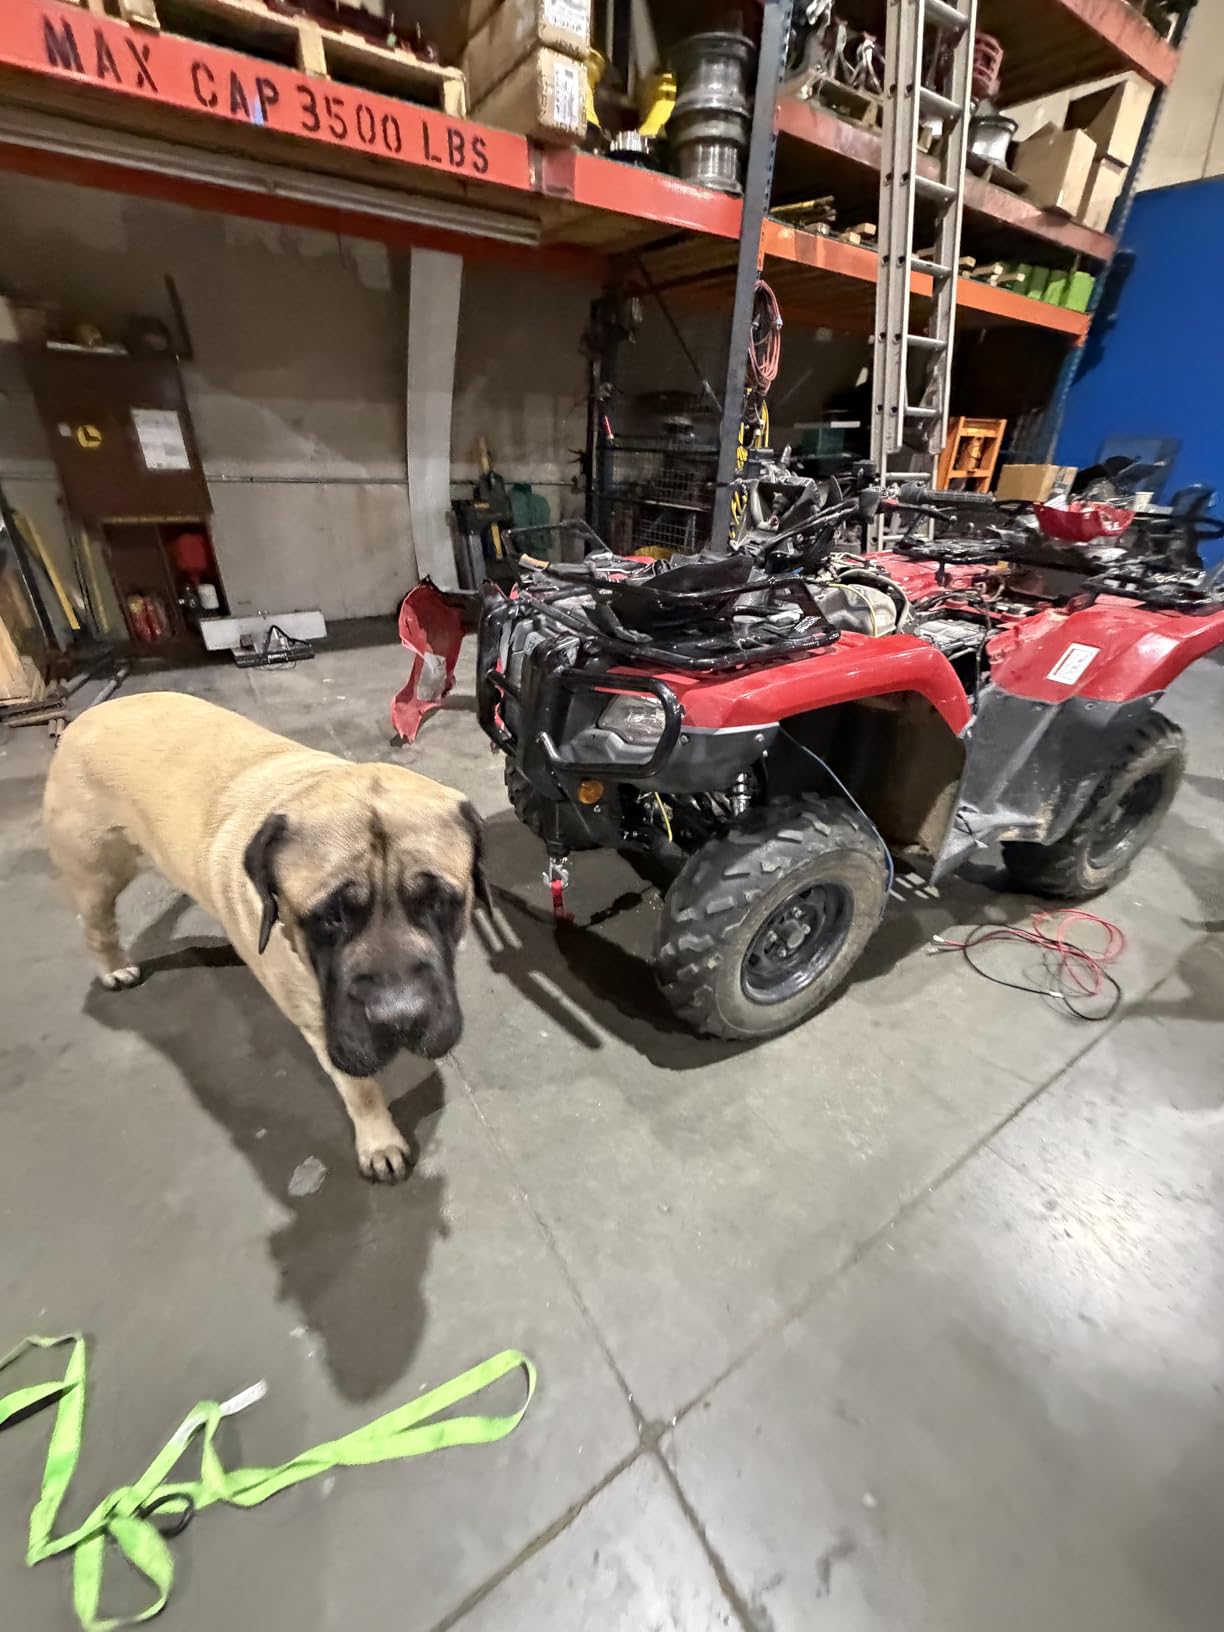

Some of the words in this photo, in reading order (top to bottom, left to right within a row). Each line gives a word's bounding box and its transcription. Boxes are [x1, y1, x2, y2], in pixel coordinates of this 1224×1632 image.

[45, 16, 157, 92] MAX
[191, 61, 280, 122] CAP
[297, 84, 402, 153] 3500
[422, 122, 489, 174] LBS
